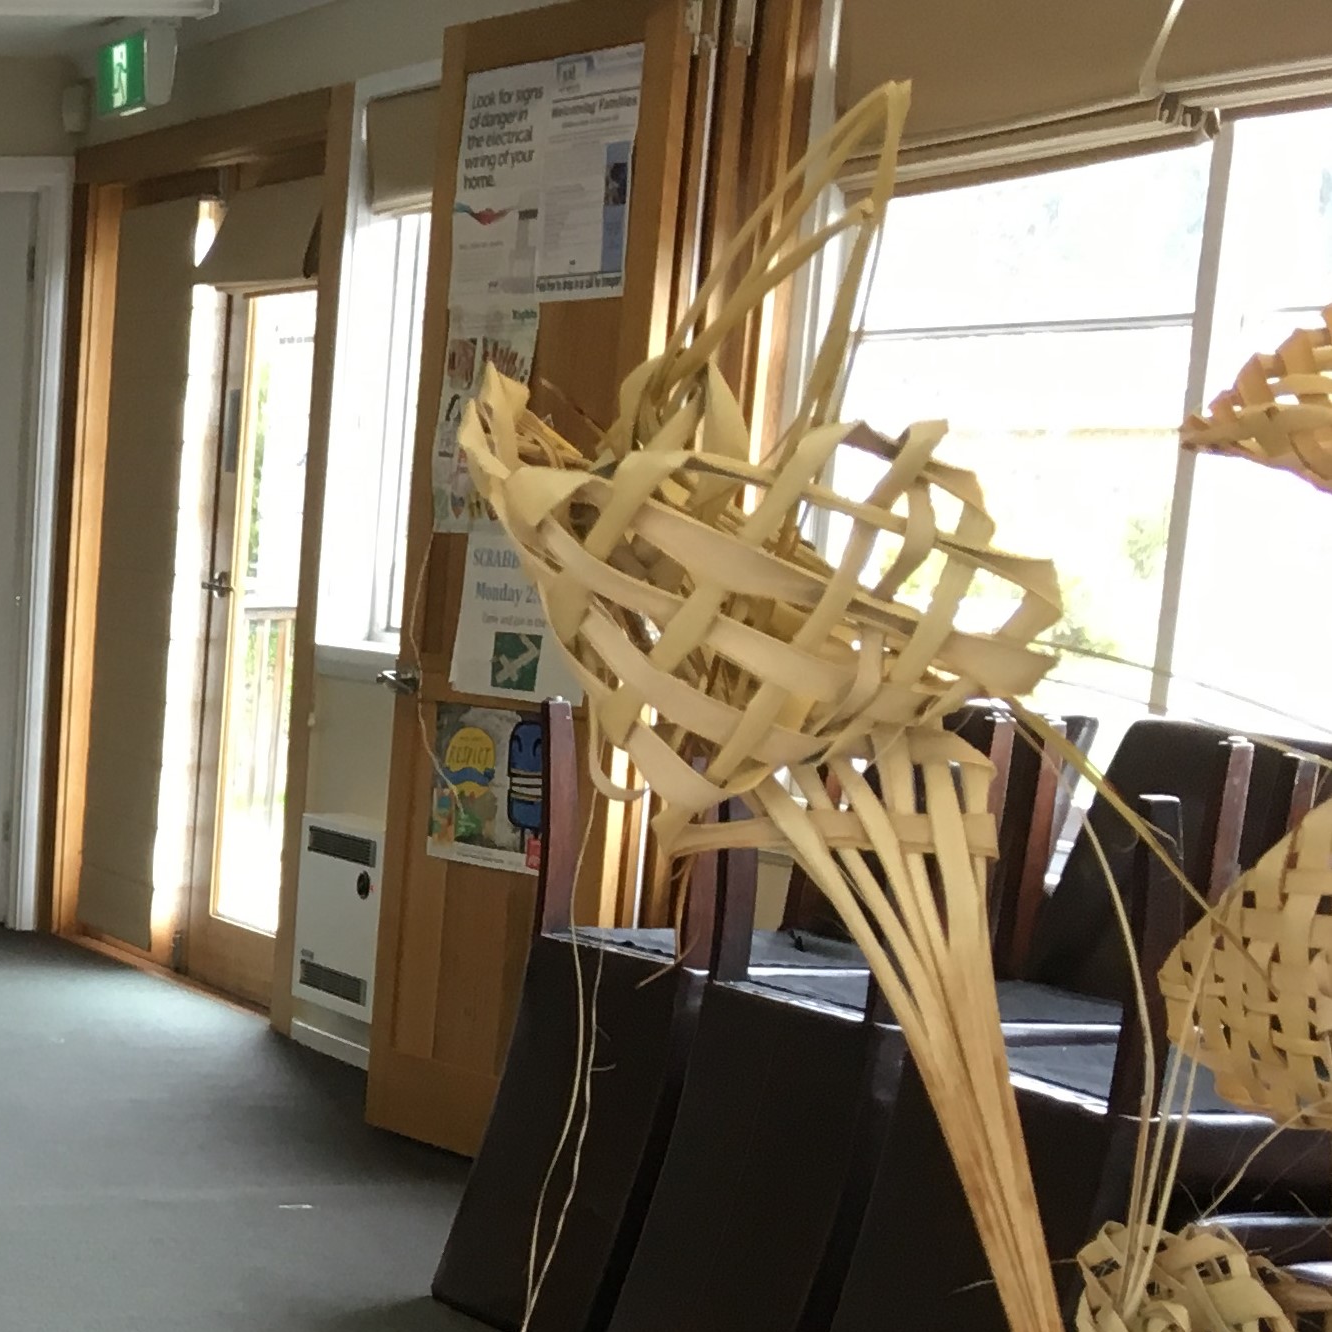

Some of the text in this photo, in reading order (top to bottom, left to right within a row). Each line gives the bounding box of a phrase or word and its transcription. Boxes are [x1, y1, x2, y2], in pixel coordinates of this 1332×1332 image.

[472, 86, 543, 110] Look for signs
[469, 108, 528, 130] of danger in
[467, 126, 533, 150] the electrical
[465, 149, 535, 170] wiring of your
[473, 550, 521, 569] SCRABB
[475, 581, 523, 607] Monday
[447, 746, 491, 764] RESPECT
